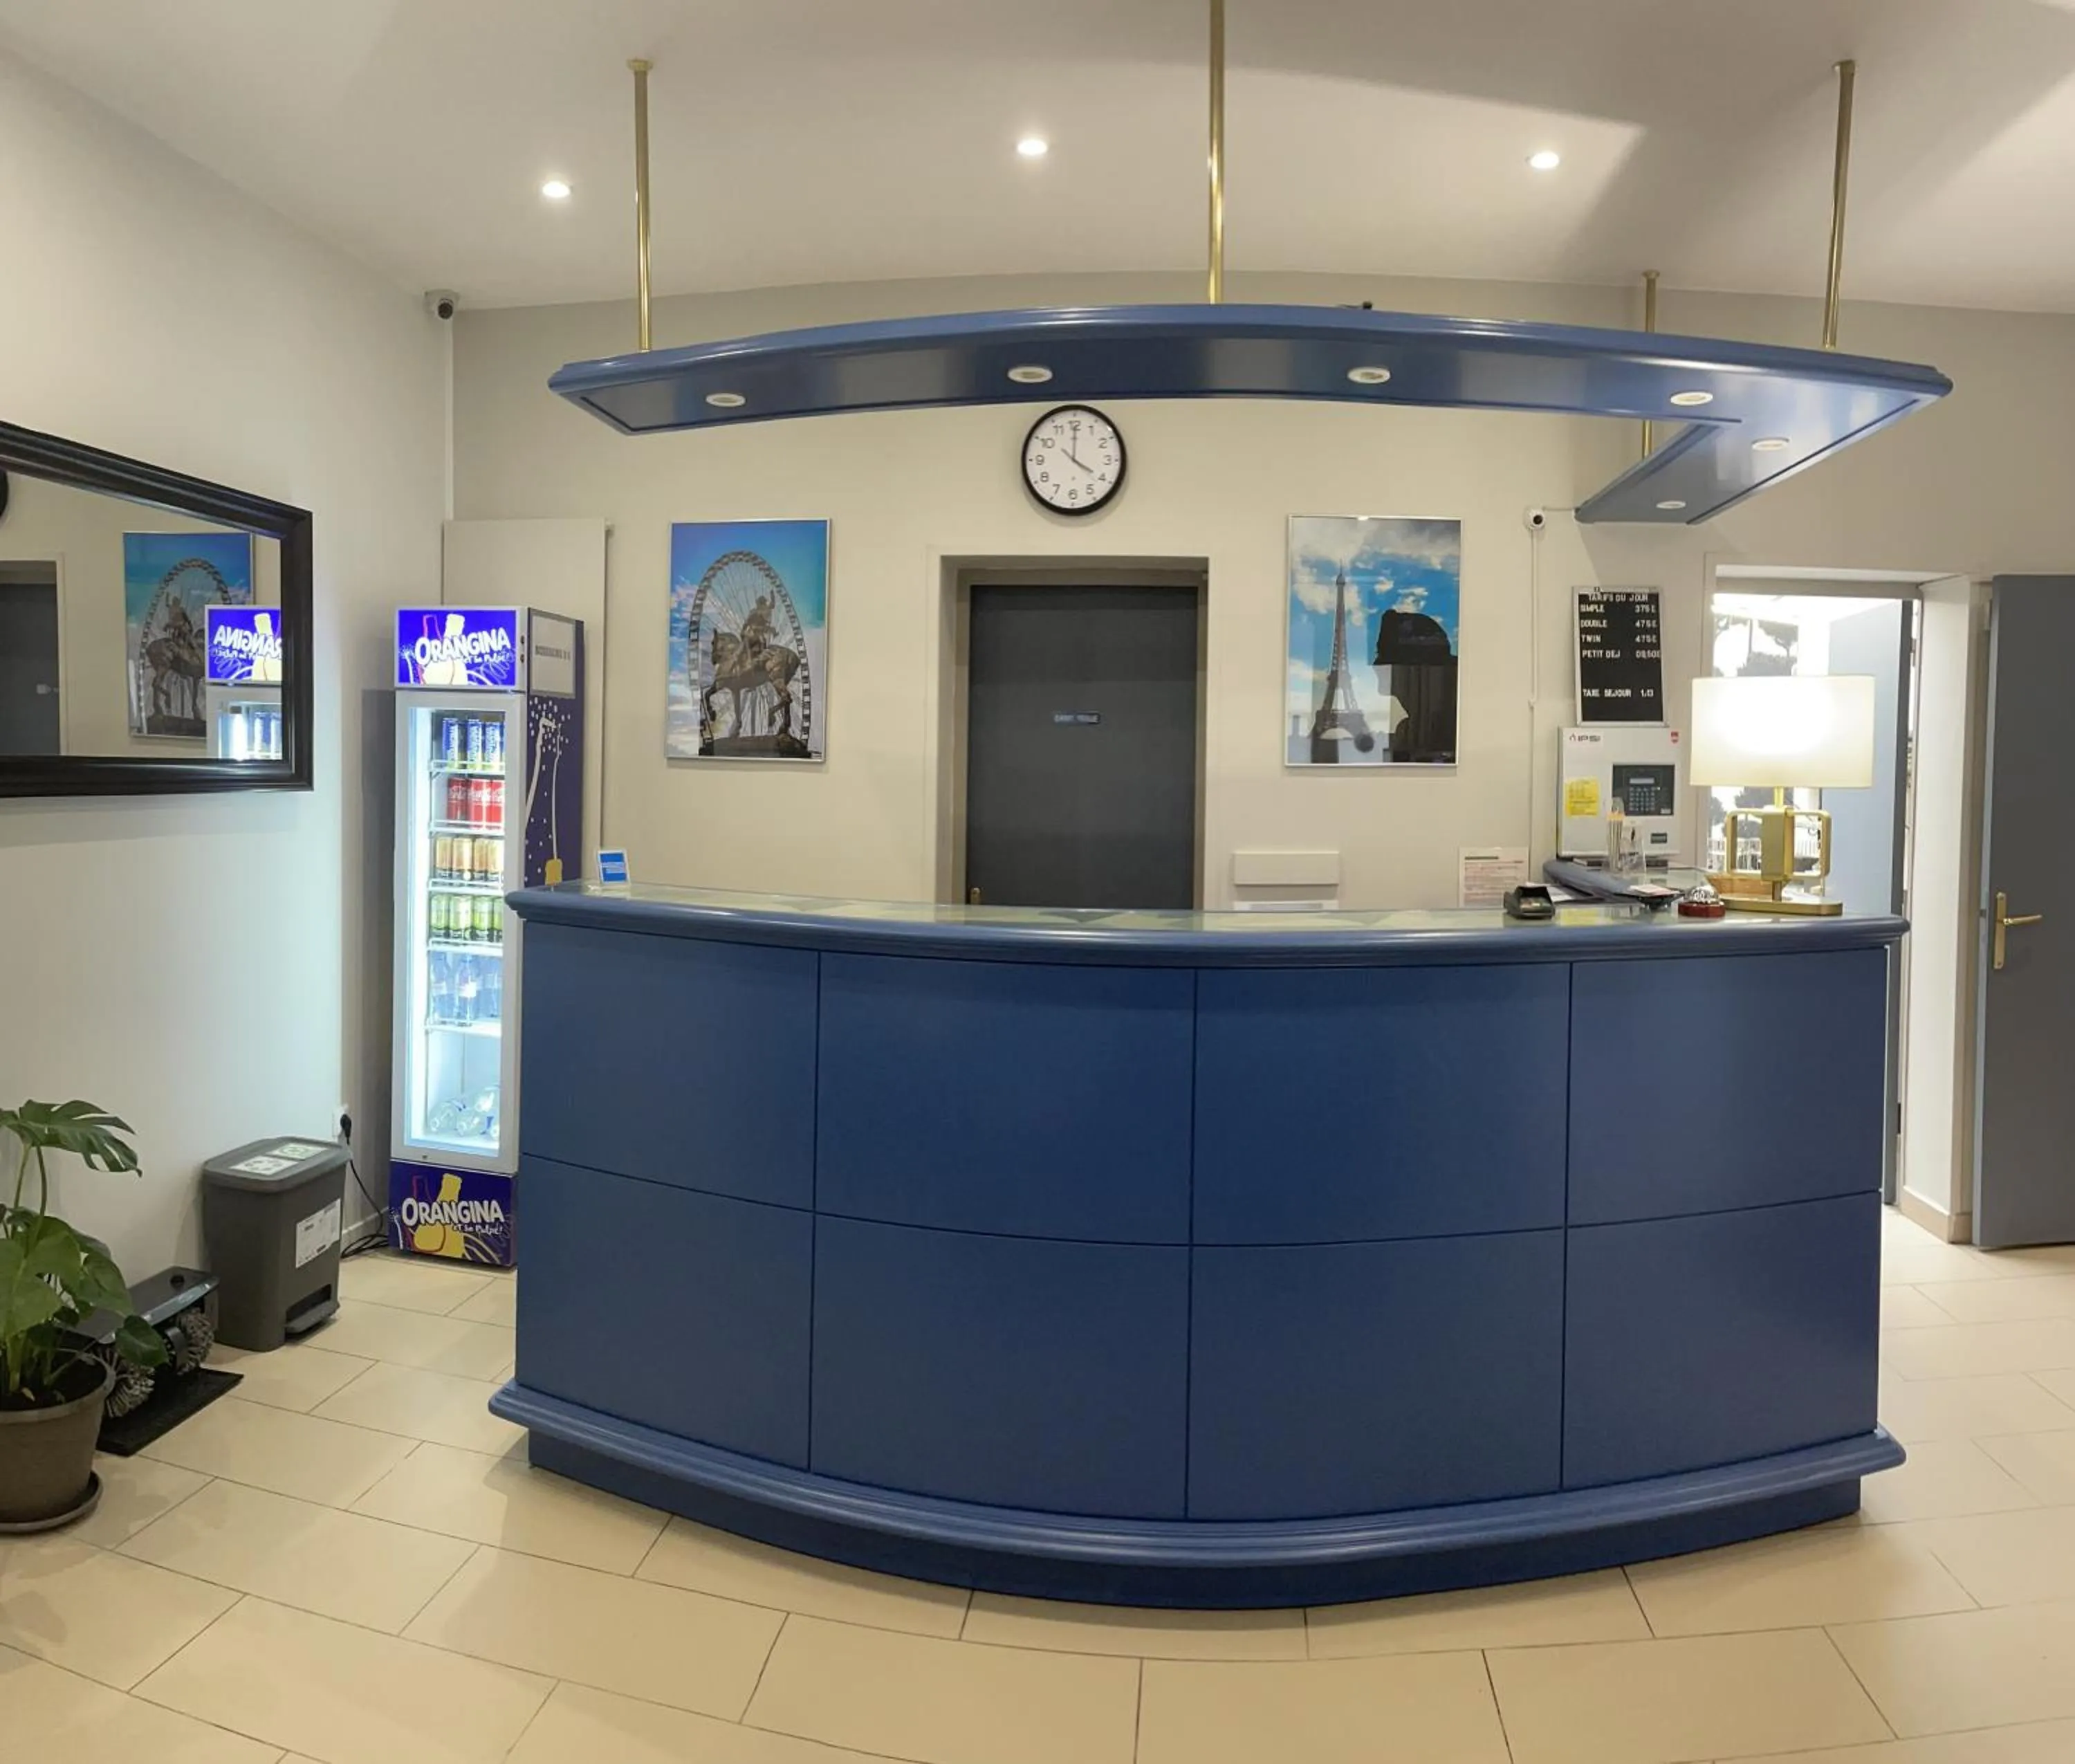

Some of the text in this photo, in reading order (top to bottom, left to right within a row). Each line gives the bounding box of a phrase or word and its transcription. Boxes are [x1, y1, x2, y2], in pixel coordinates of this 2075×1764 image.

[1053, 425, 1064, 435] 11
[1068, 420, 1081, 431] 12
[1088, 425, 1094, 435] 1
[1040, 438, 1055, 448] 10
[1098, 438, 1107, 448] 2
[1035, 454, 1044, 466] 9
[1104, 454, 1112, 466] 3
[1040, 472, 1049, 482] 8
[1098, 473, 1106, 481] 4
[1052, 484, 1061, 494] 7
[1068, 489, 1078, 499] 6
[1086, 484, 1094, 495] 5
[1629, 594, 1648, 602] JOUR
[1580, 604, 1605, 613] SIMPLE
[1581, 634, 1601, 643] TWIN
[415, 627, 511, 665] ORANGINA
[1583, 650, 1604, 658] PETIT
[1583, 689, 1600, 697] TAXE
[402, 1197, 505, 1226] ORANGINA
